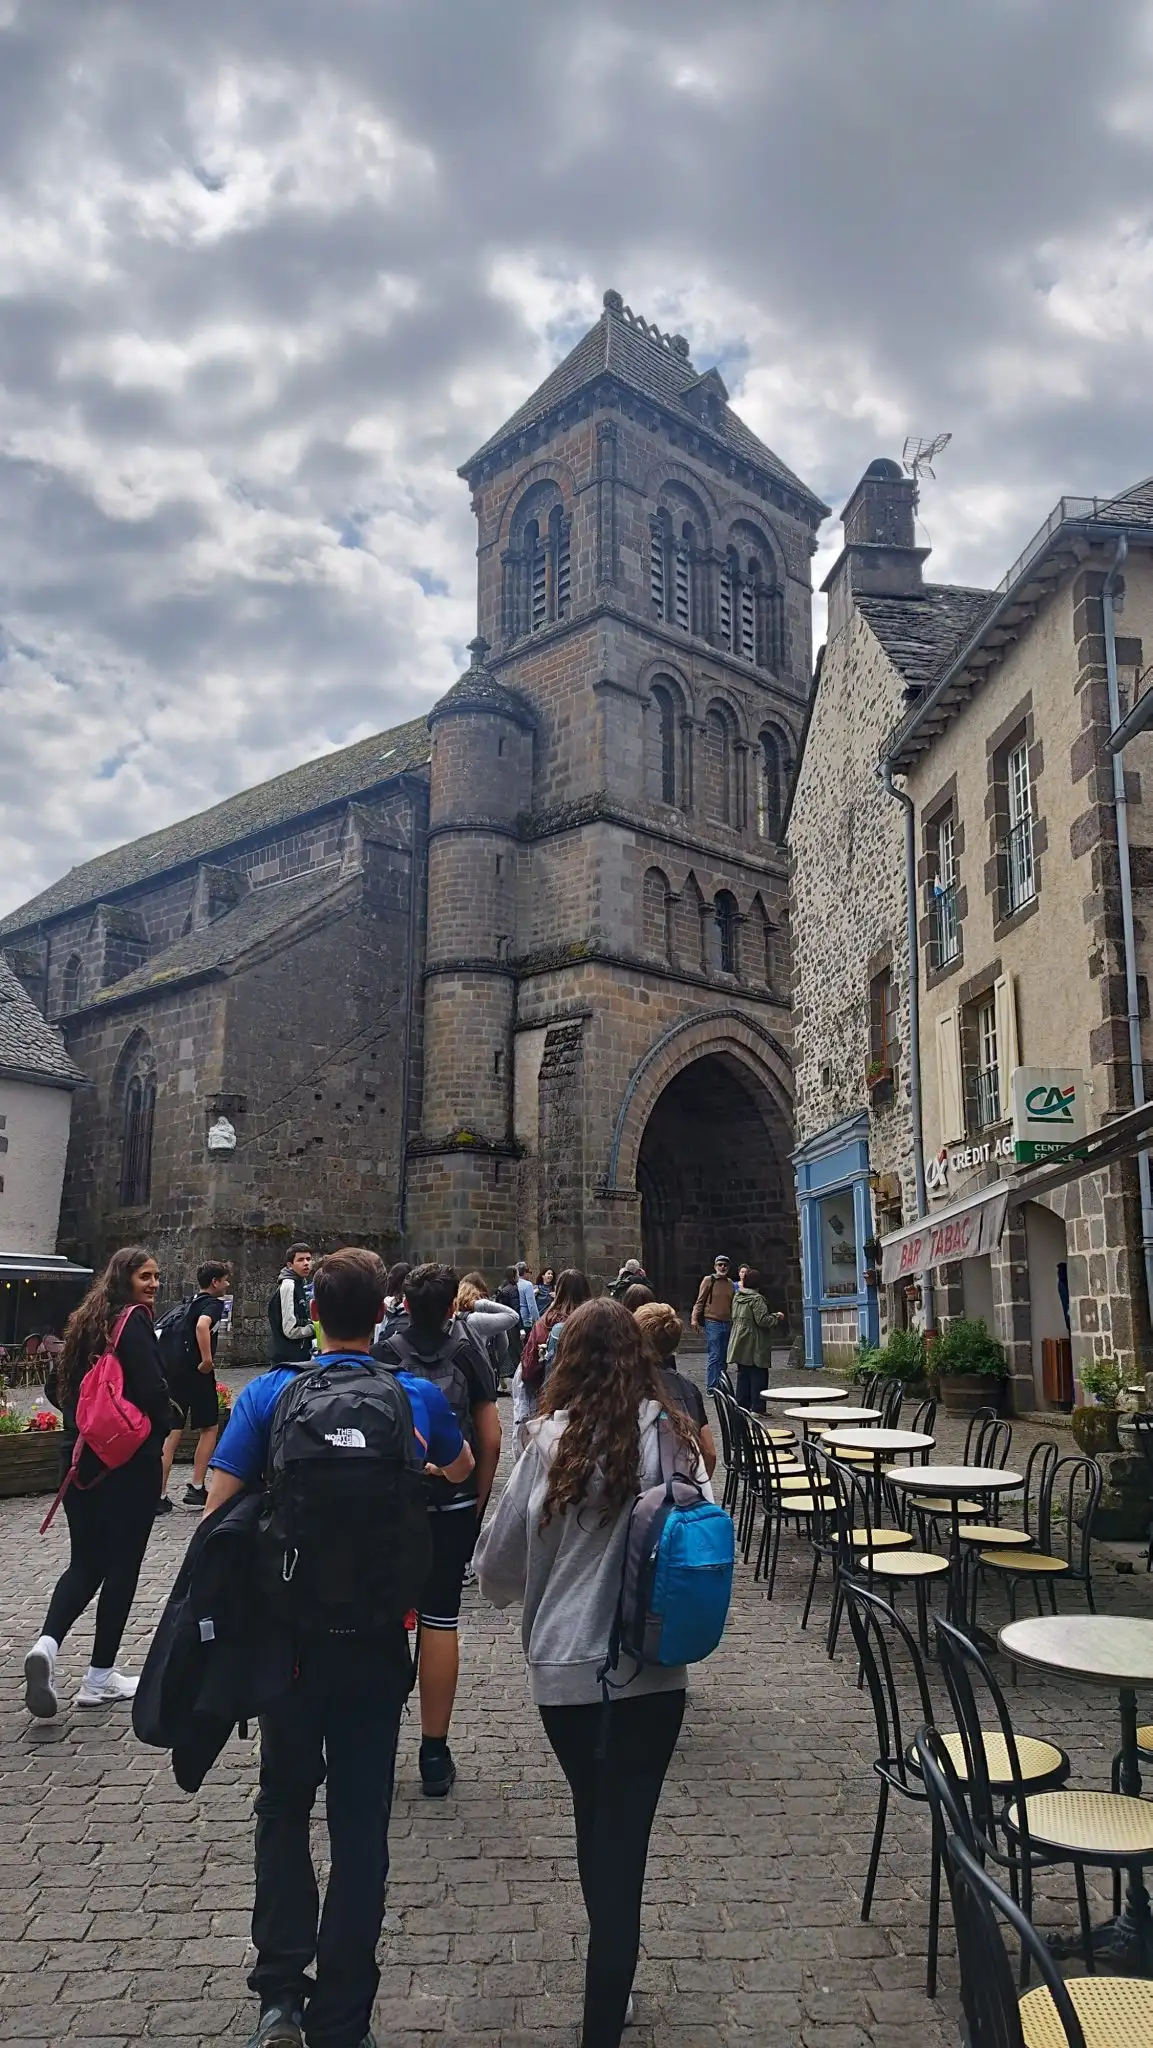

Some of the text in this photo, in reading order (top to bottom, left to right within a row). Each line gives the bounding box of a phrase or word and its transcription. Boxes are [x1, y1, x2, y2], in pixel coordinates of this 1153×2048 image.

[951, 1144, 990, 1171] CRÉDIT
[901, 1217, 970, 1269] BAR TABAC
